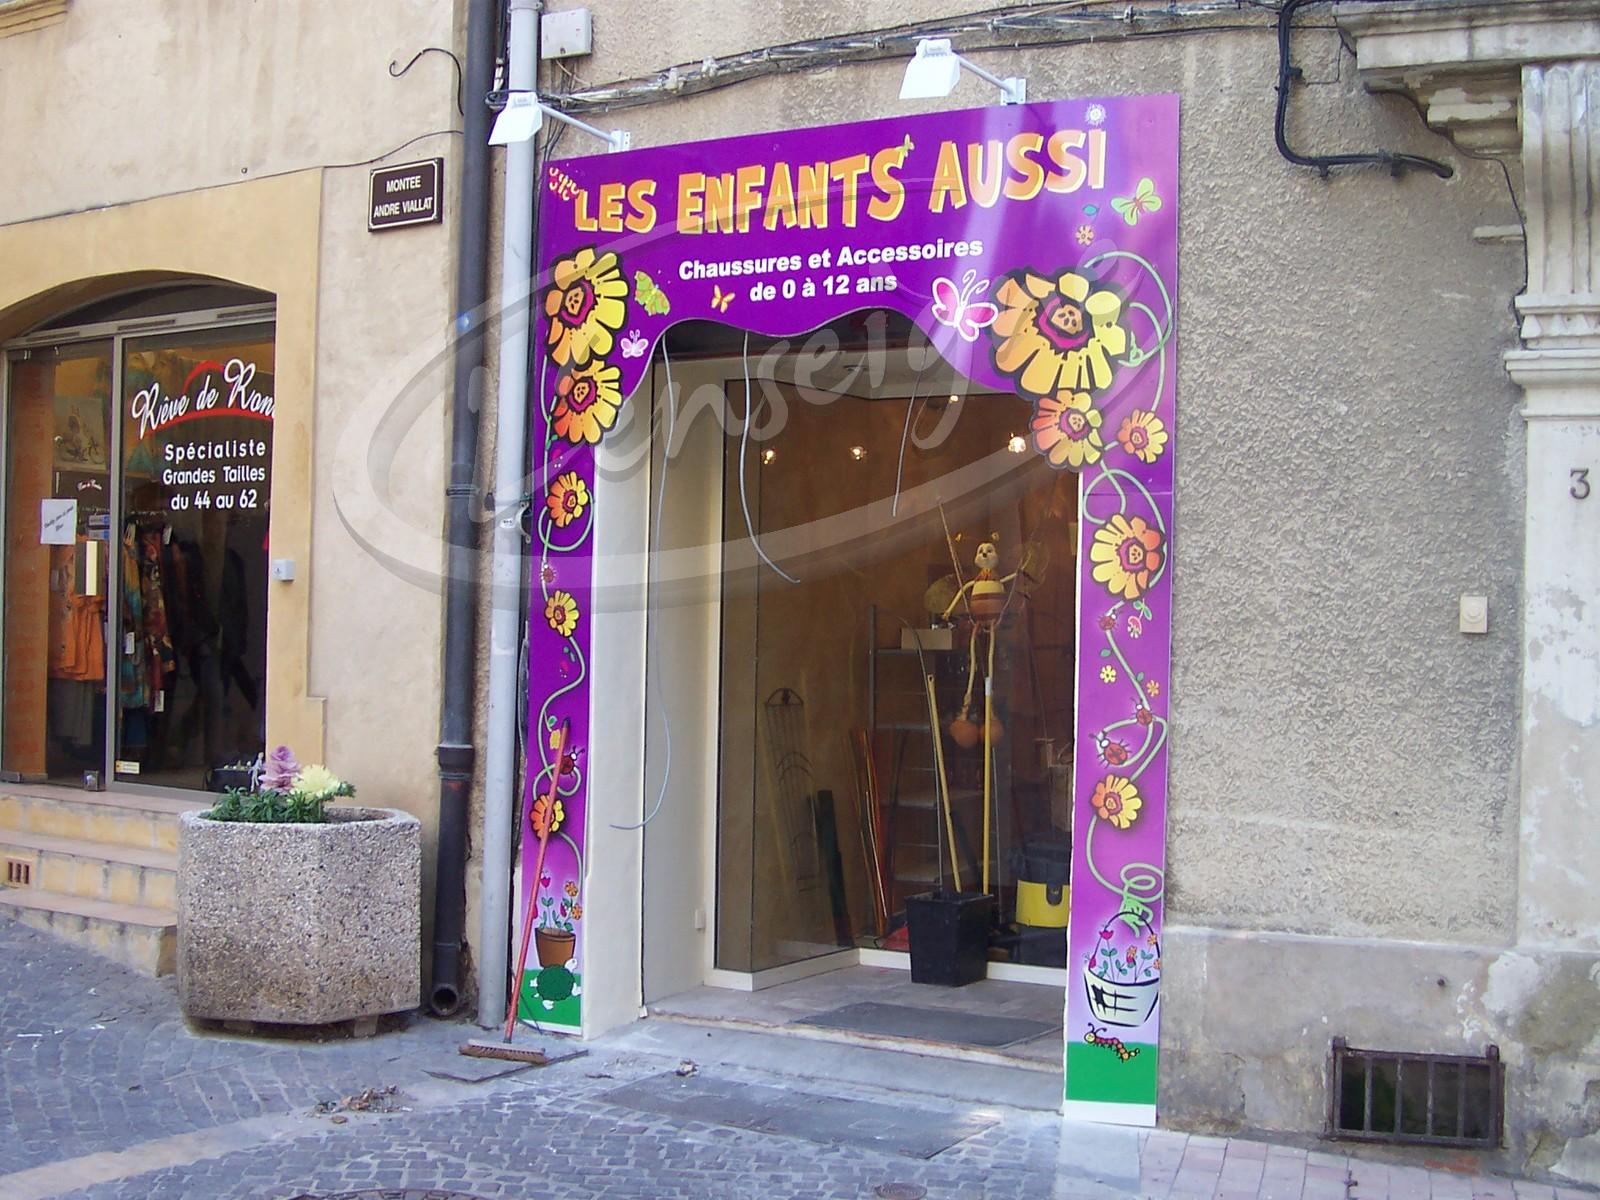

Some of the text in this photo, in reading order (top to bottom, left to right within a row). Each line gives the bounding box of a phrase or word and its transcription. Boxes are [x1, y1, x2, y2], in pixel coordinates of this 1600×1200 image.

[386, 176, 421, 193] MONTEE
[574, 129, 1107, 234] LES ENFANTS AUSSI
[373, 197, 433, 218] ANDRE VIALLAT
[678, 238, 984, 280] Chaussures et Accessoires
[749, 274, 898, 302] de 0 à 12 ans
[131, 383, 190, 440] Rêve
[196, 375, 219, 411] de
[164, 439, 266, 465] Spécialiste
[162, 464, 266, 486] Grandes Tailles
[1570, 467, 1591, 500] 3
[170, 488, 258, 511] du 44 au 62
